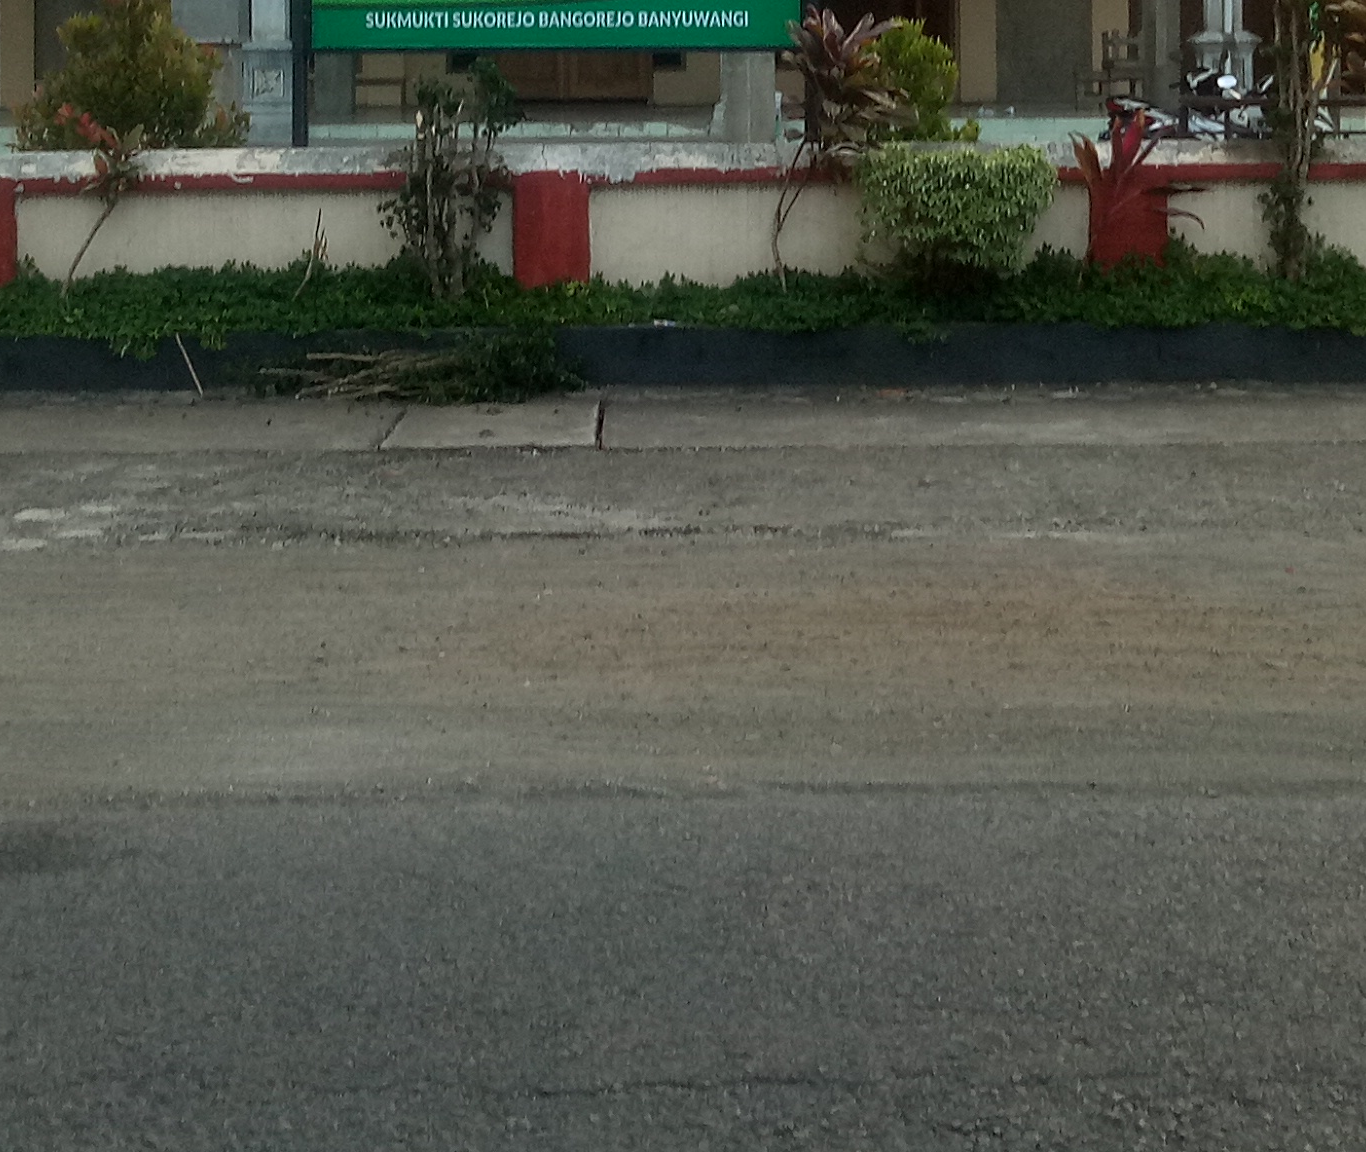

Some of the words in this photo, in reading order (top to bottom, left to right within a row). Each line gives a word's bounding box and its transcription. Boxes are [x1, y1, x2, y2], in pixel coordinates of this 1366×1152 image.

[365, 10, 449, 29] SUKMUKTI
[452, 10, 535, 29] SUKOREJO
[538, 10, 635, 29] BANGOREJO
[638, 10, 749, 29] BANYUWANGI
